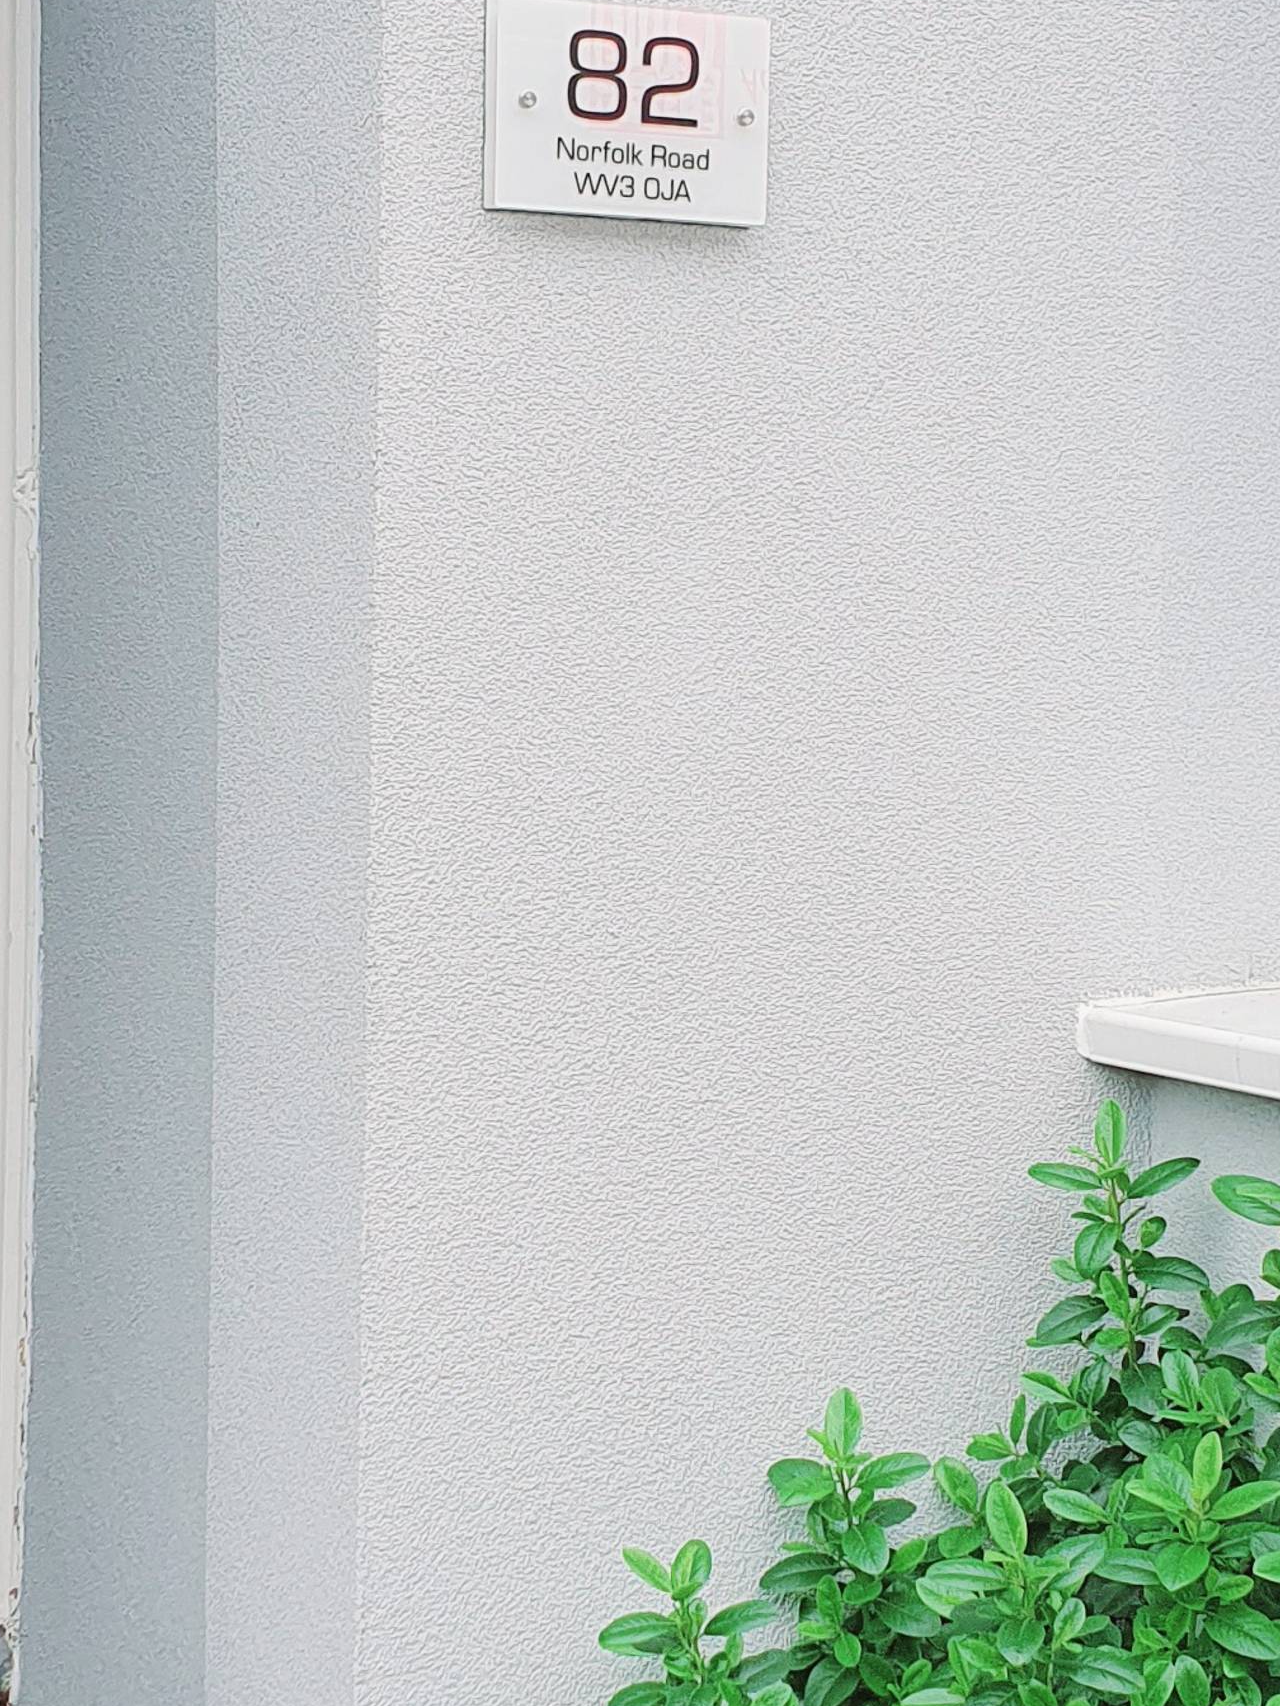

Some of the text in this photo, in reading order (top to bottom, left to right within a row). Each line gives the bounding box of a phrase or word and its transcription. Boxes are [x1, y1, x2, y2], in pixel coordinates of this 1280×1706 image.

[567, 29, 700, 128] 82
[556, 136, 710, 171] Norfolk Road
[573, 171, 635, 198] WV3
